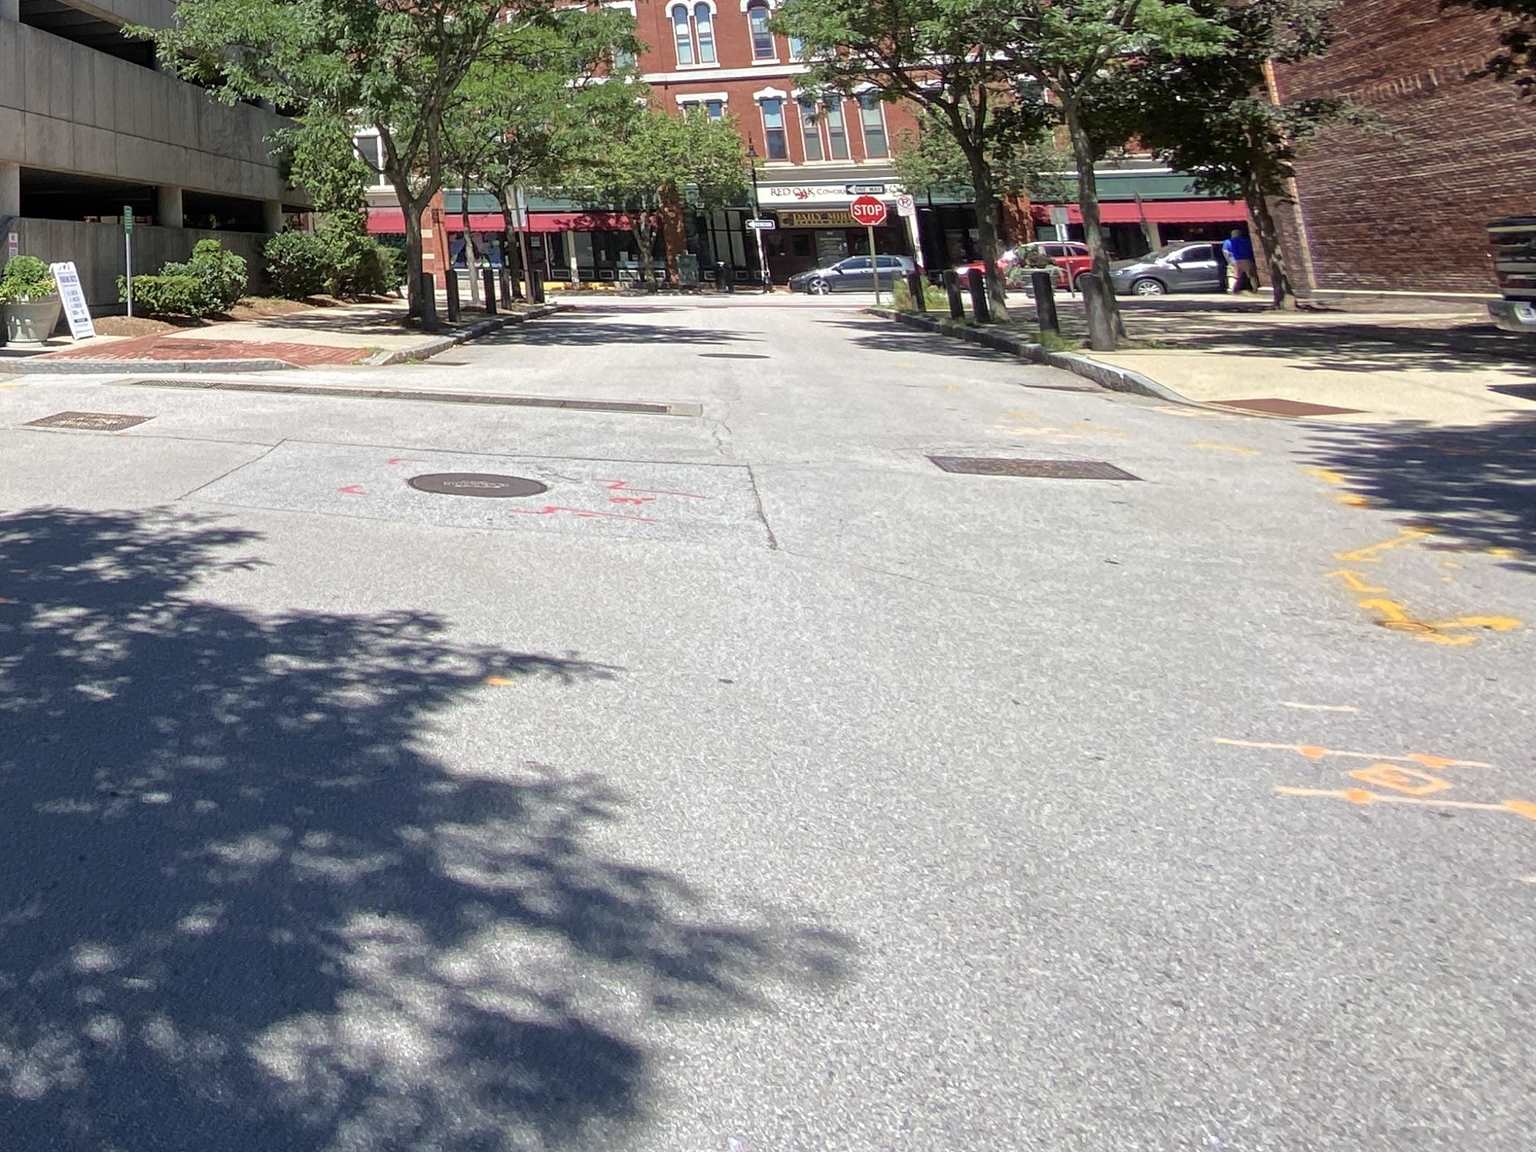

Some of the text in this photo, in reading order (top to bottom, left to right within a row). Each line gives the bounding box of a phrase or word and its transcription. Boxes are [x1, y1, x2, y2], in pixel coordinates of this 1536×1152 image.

[770, 187, 791, 196] RED
[792, 186, 816, 197] OAK
[854, 204, 883, 216] STOP
